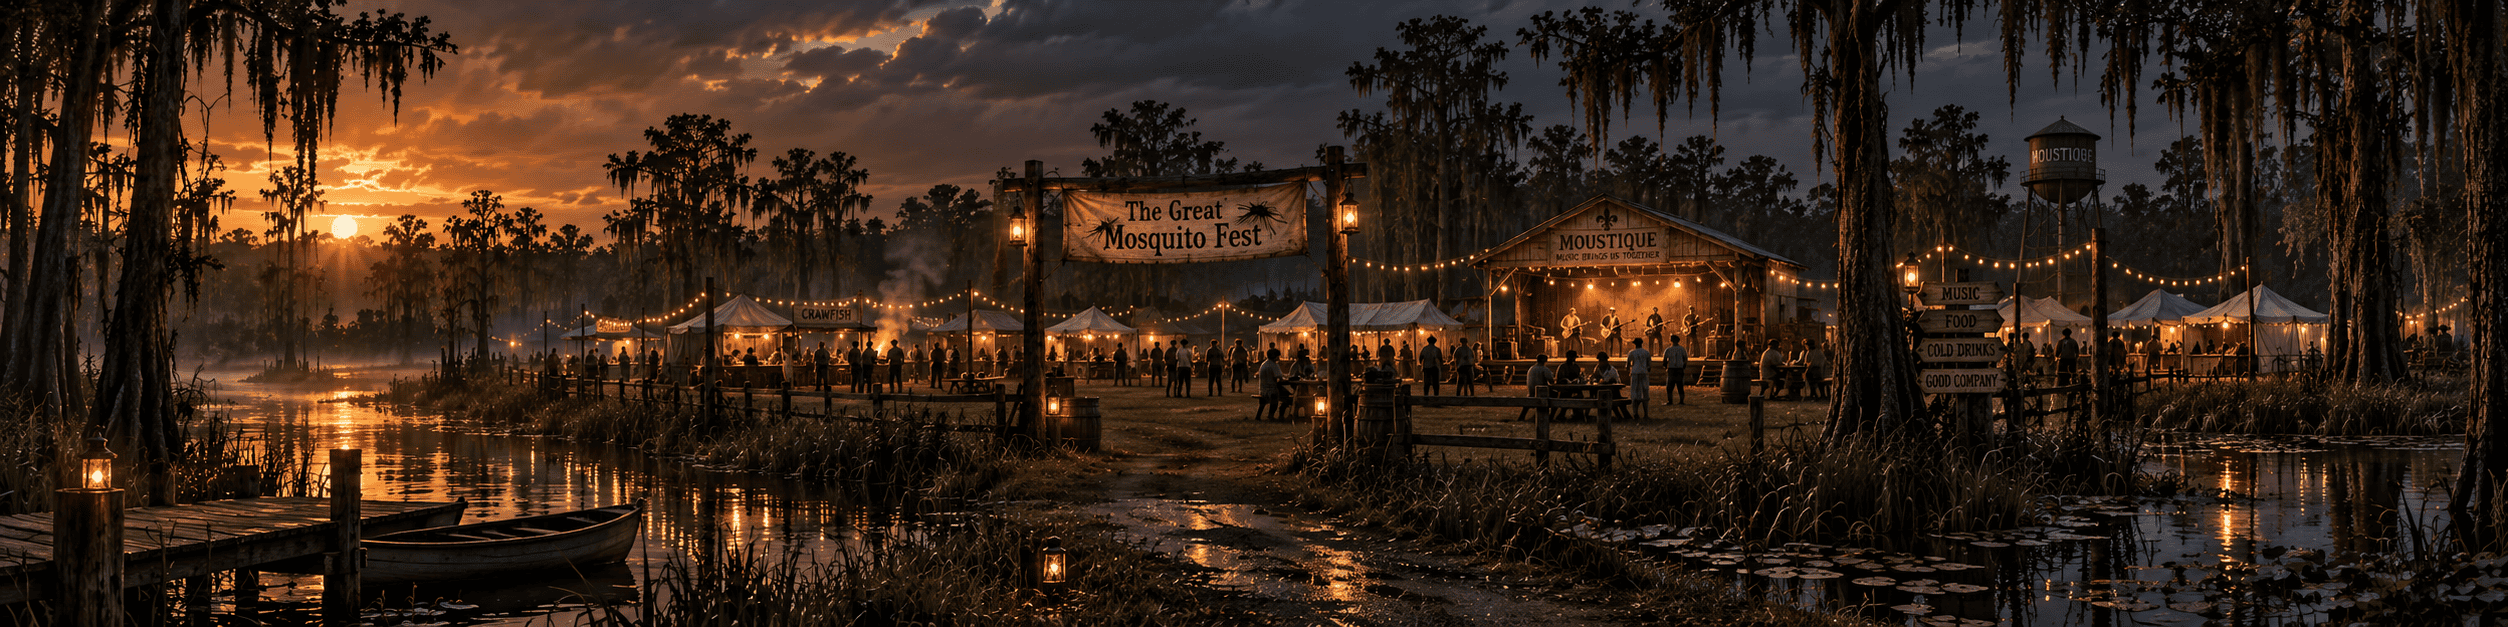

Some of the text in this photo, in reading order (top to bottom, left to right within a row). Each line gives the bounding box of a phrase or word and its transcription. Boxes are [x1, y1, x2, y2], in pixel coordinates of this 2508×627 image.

[1125, 200, 1223, 222] The Great
[1104, 223, 1263, 257] Mosquito Fest
[1559, 232, 1657, 251] MOUSTIQUE
[1941, 287, 1980, 300] MUSIC
[802, 308, 852, 320] CRAWFISH
[1945, 314, 1977, 328] FOOD
[1927, 343, 1996, 358] COLD DRINKS
[1953, 373, 1998, 388] COMPANY
